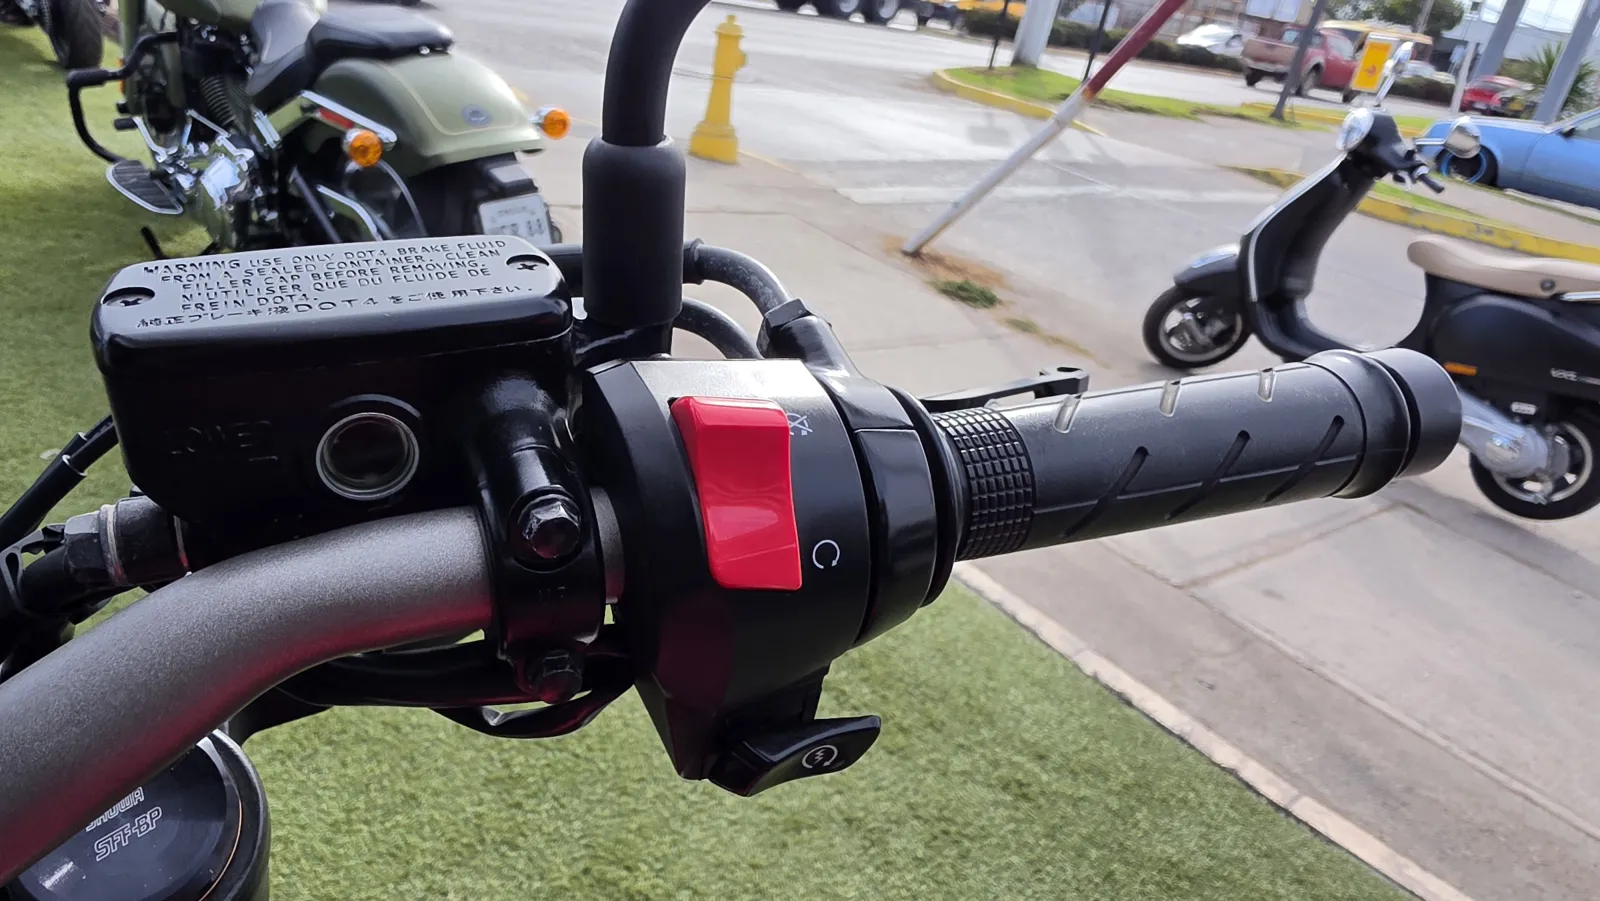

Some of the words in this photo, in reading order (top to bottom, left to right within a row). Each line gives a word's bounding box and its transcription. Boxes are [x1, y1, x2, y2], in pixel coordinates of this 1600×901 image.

[161, 272, 211, 283] FROM
[223, 270, 233, 279] A
[244, 263, 317, 277] SEALED
[325, 254, 434, 270] CONTAINER.
[445, 249, 501, 261] CLEAN
[249, 256, 283, 268] USE
[292, 253, 334, 265] ONLY
[344, 249, 387, 260] DOT4
[397, 243, 449, 256] BRAKE
[457, 240, 506, 251] FLUID
[181, 284, 302, 303] N'UTILISER
[312, 280, 349, 293] QUE
[358, 277, 382, 288] DU
[392, 270, 460, 284] FLUIDE
[467, 267, 492, 278] DE
[182, 278, 253, 291] FILLER
[264, 274, 301, 285] CAP
[311, 267, 380, 281] BEFORE
[390, 259, 486, 274] REMOVING.
[181, 299, 246, 312] FREIN
[257, 293, 319, 306] DOT4.
[94, 806, 163, 861] SFF-BP
